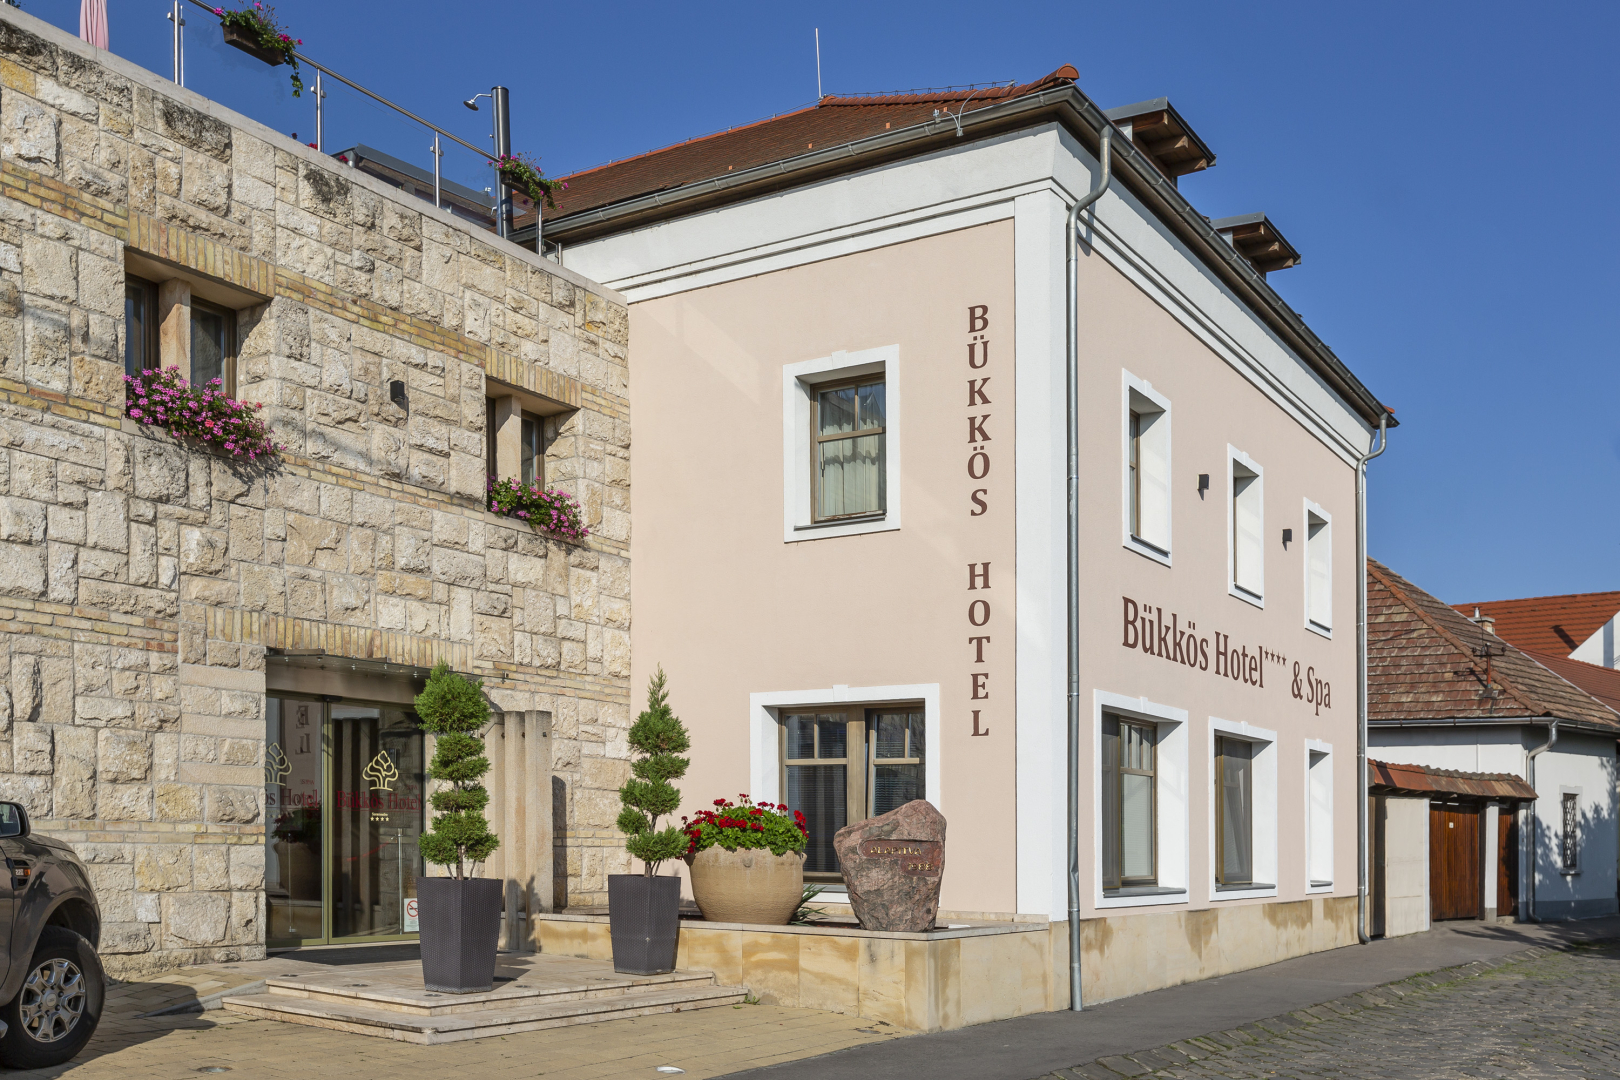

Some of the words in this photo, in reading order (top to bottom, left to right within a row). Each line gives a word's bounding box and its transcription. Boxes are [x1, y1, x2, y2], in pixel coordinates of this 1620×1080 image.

[967, 303, 993, 517] BÜKKÖS
[967, 561, 992, 737] HOTEL
[1122, 596, 1209, 671] Bükkös
[1215, 631, 1264, 688] Hotel
[1291, 661, 1303, 700] &
[1306, 666, 1331, 716] Spa
[281, 788, 318, 807] Hotel
[336, 790, 385, 809] Bükkös
[388, 792, 421, 810] Hotel
[908, 863, 933, 871] 1988
